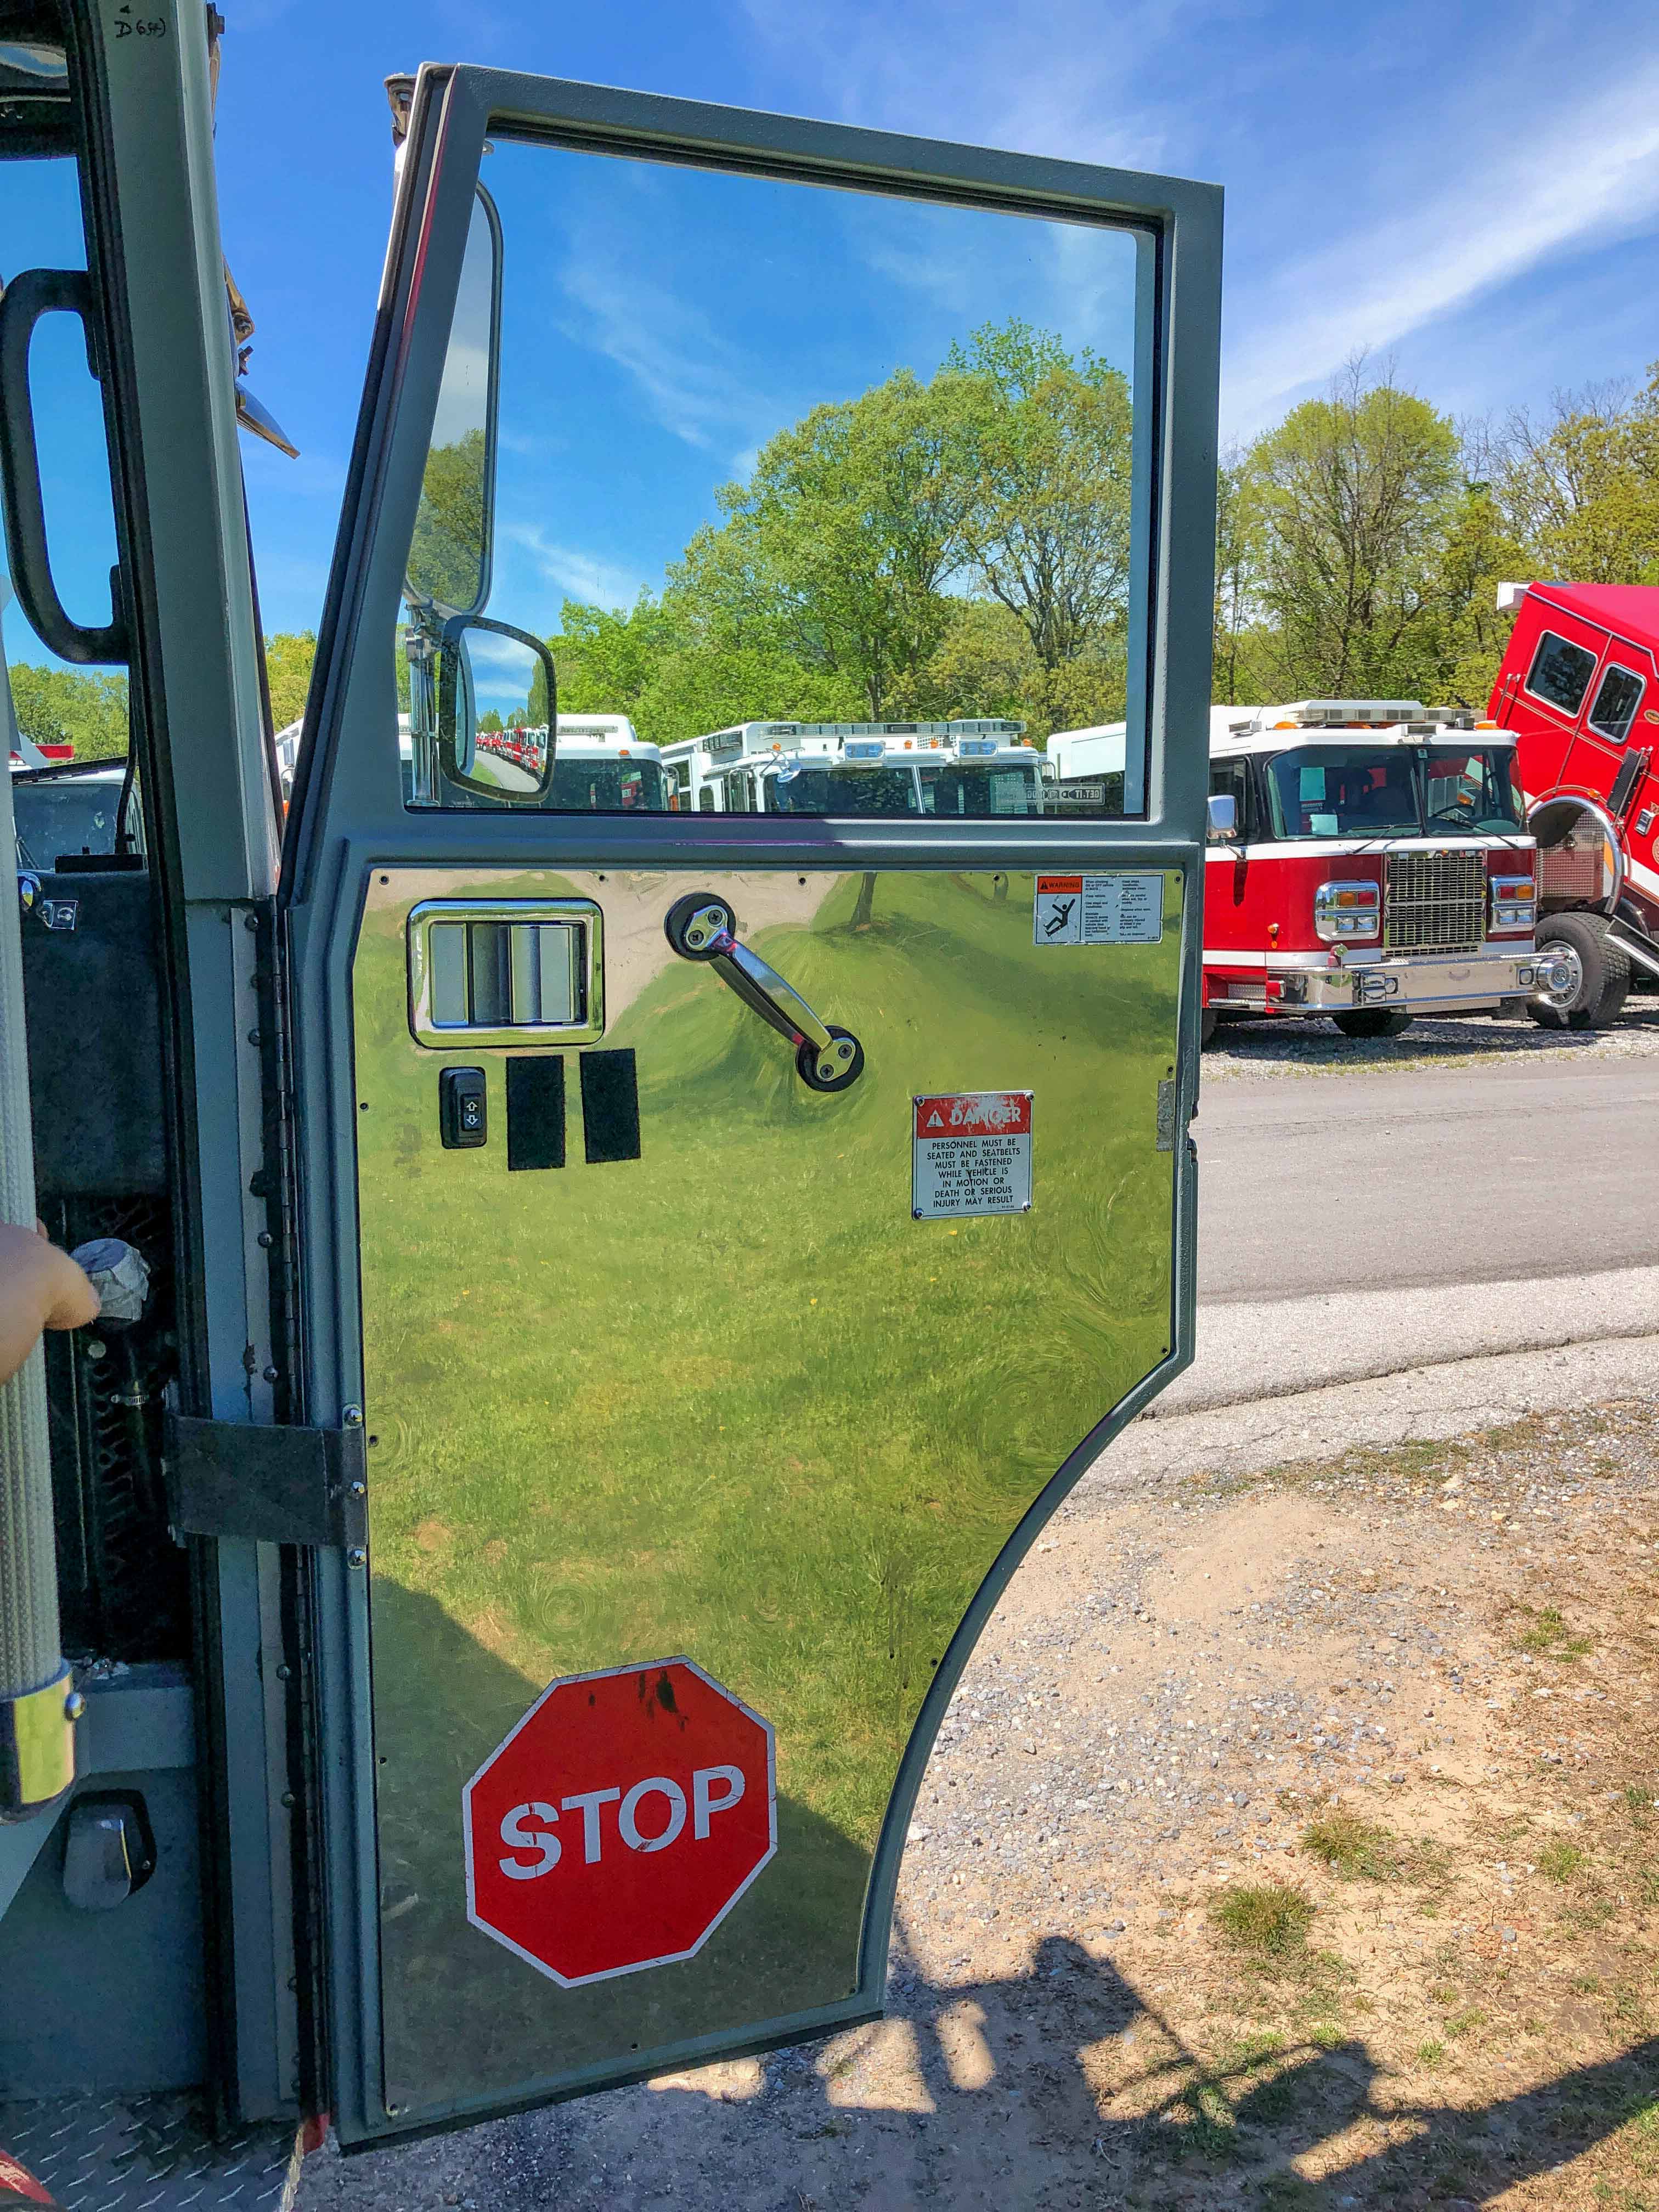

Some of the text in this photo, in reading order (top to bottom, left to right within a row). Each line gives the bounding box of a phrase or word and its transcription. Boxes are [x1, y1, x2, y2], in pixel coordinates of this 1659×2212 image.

[951, 1106, 1022, 1126] DANGER
[932, 1138, 1016, 1150] PERSONNEL MUST BE
[927, 1147, 1020, 1160] SEATED AND SEATBELTS
[934, 1161, 956, 1169] MUST
[974, 1158, 1012, 1167] FASTENED
[938, 1170, 962, 1178] WHILE
[966, 1167, 997, 1177] VEHICLE
[943, 1180, 951, 1188] IN
[956, 1178, 988, 1187] MOTION
[934, 1186, 1012, 1198] DEATH OR SERIOUS
[933, 1195, 1014, 1208] INJURY MAY RESULT
[499, 1764, 746, 1880] STOP
